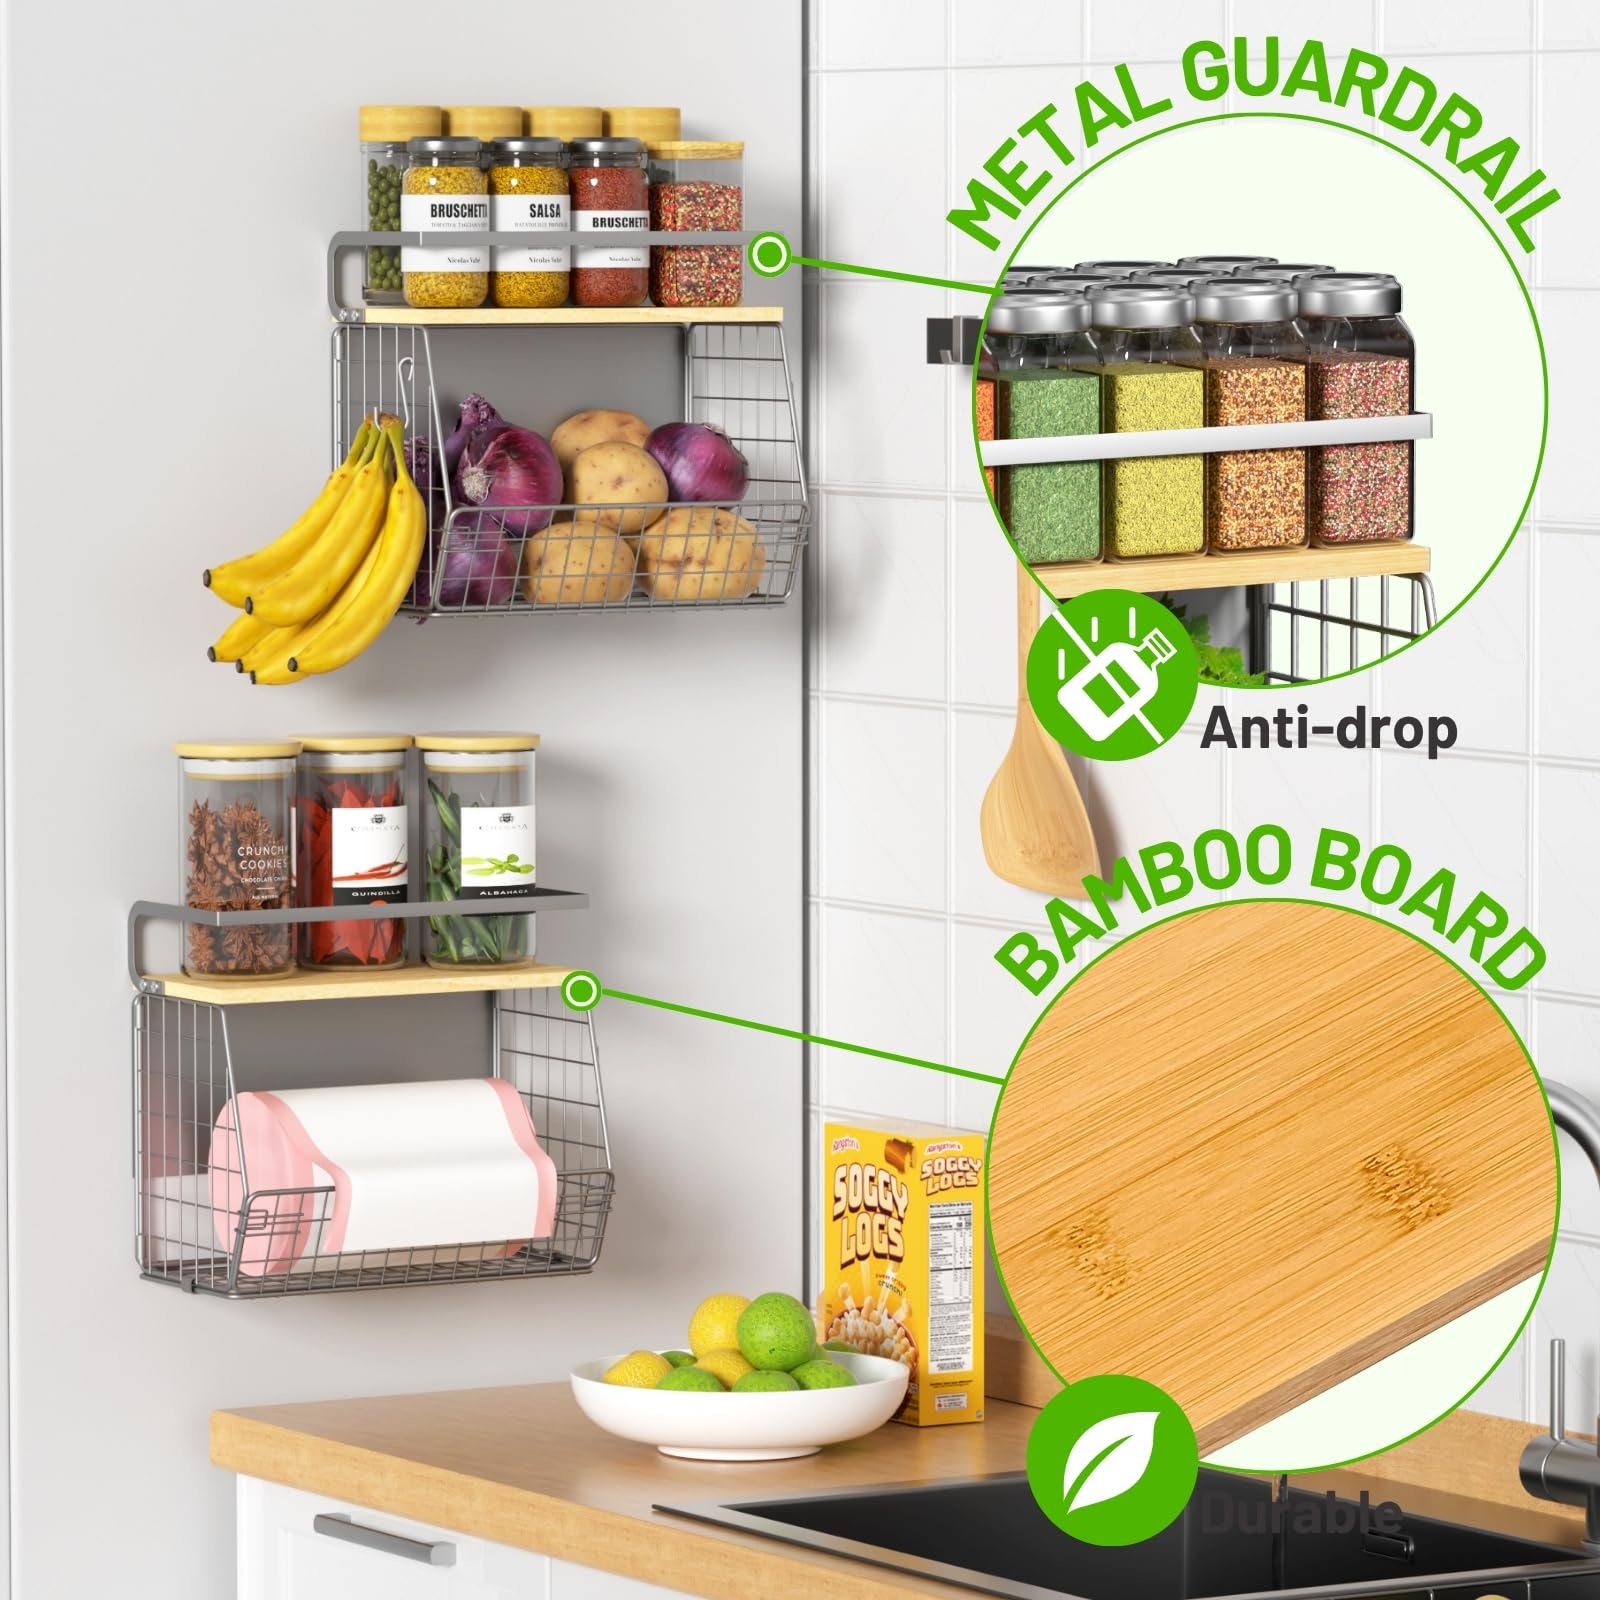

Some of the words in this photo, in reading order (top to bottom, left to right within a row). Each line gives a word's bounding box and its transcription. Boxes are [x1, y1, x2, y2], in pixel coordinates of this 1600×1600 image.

[529, 203, 561, 219] SALSA
[240, 858, 288, 870] COOKIES
[240, 876, 272, 884] CHOCOLATE
[920, 1156, 983, 1181] SOGGY
[833, 1162, 909, 1224] SOGGY
[926, 1171, 980, 1197] LOGS
[840, 1212, 904, 1271] LOGS
